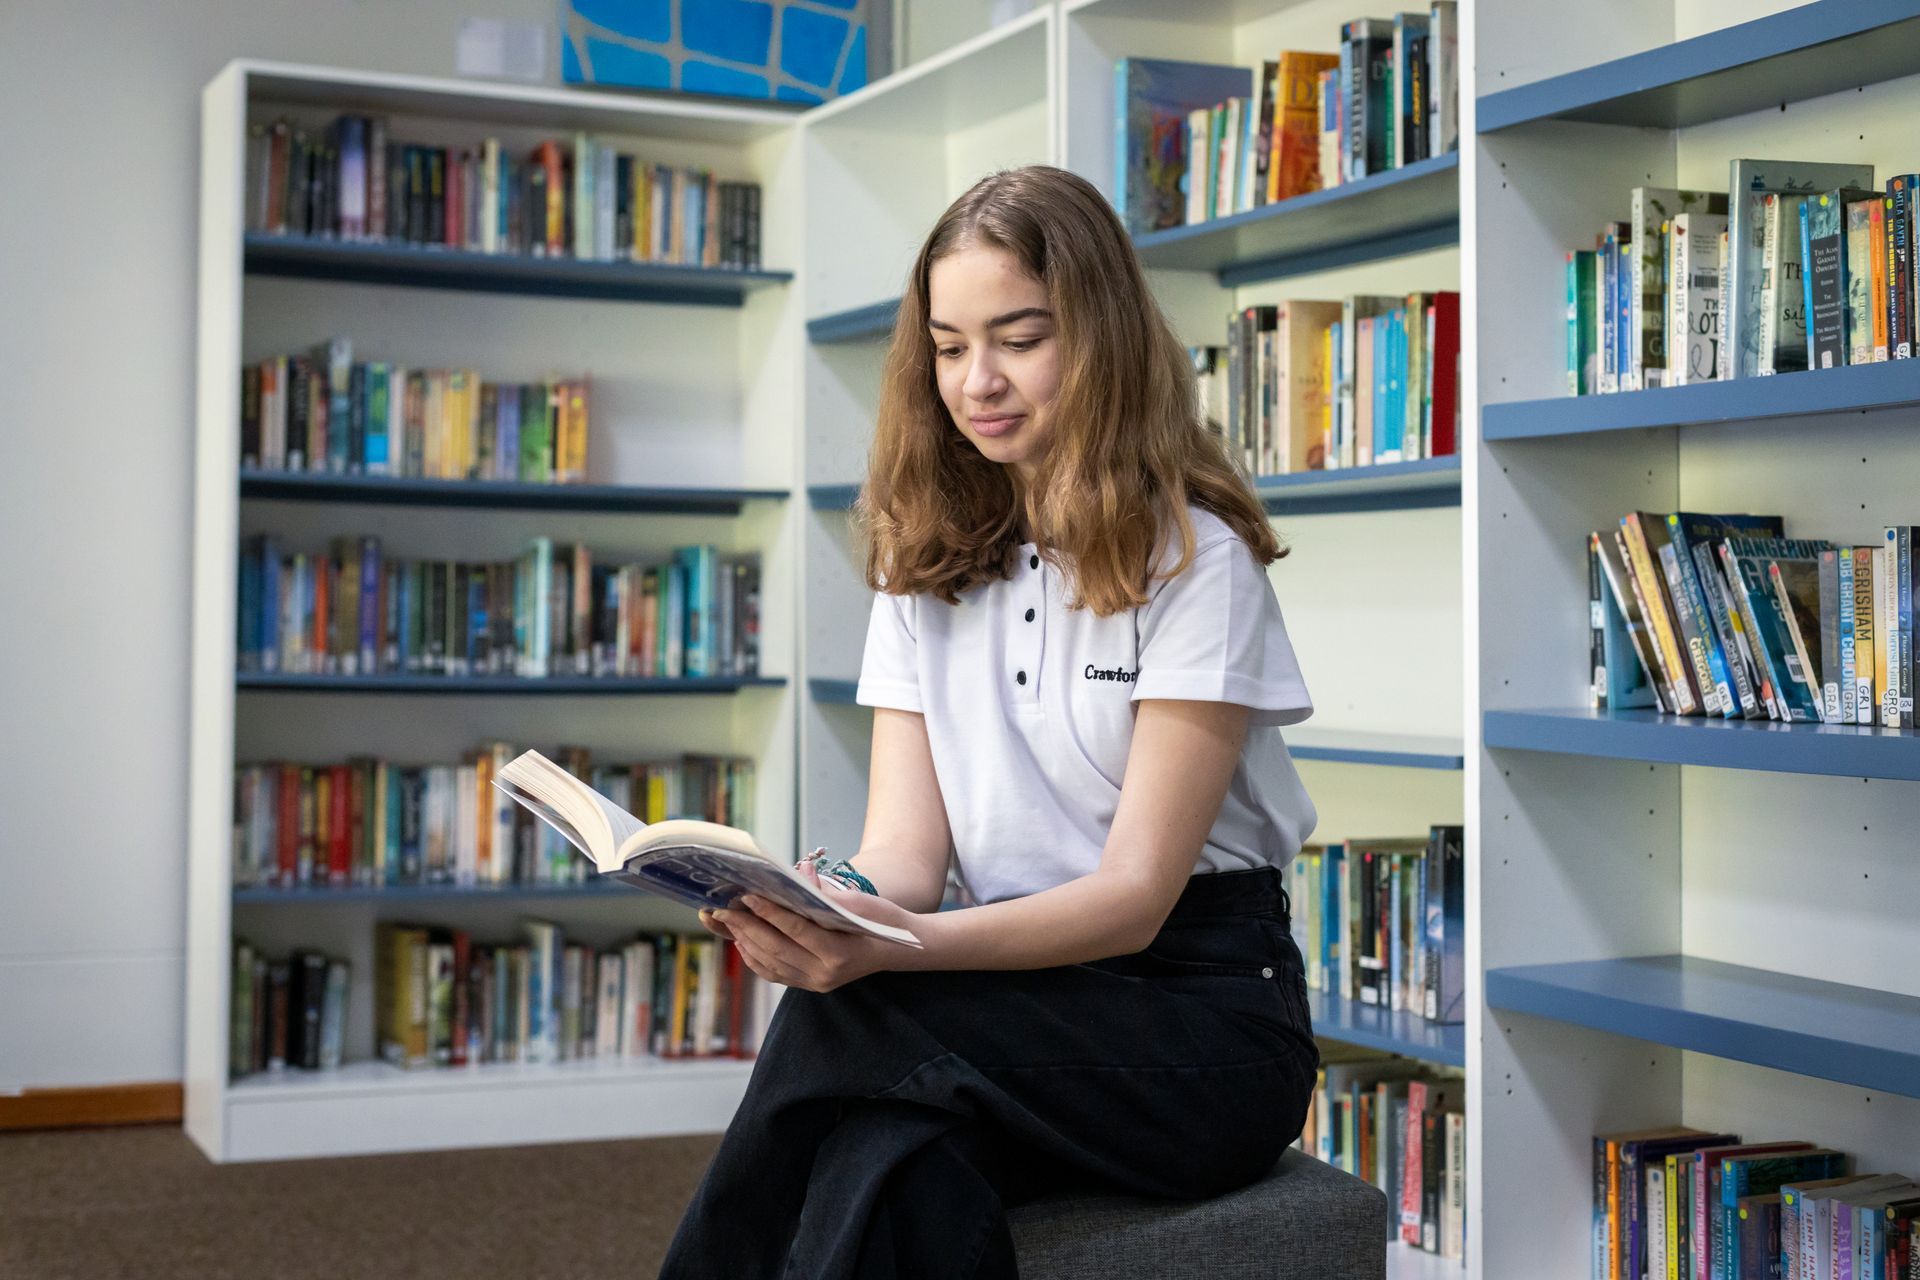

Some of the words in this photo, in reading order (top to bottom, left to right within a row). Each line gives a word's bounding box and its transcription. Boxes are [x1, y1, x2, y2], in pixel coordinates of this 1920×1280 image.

[1840, 557, 1852, 578] OB
[1841, 582, 1853, 623] GRANT
[1855, 567, 1871, 641] GRISHAM
[1688, 636, 1715, 695] GREGORY
[1725, 640, 1738, 666] JOHN
[1842, 637, 1855, 690] COLON
[1844, 692, 1854, 720] GRA
[1859, 685, 1869, 711] GRI
[1888, 688, 1898, 715] GRO
[1806, 1212, 1816, 1252] JENNY
